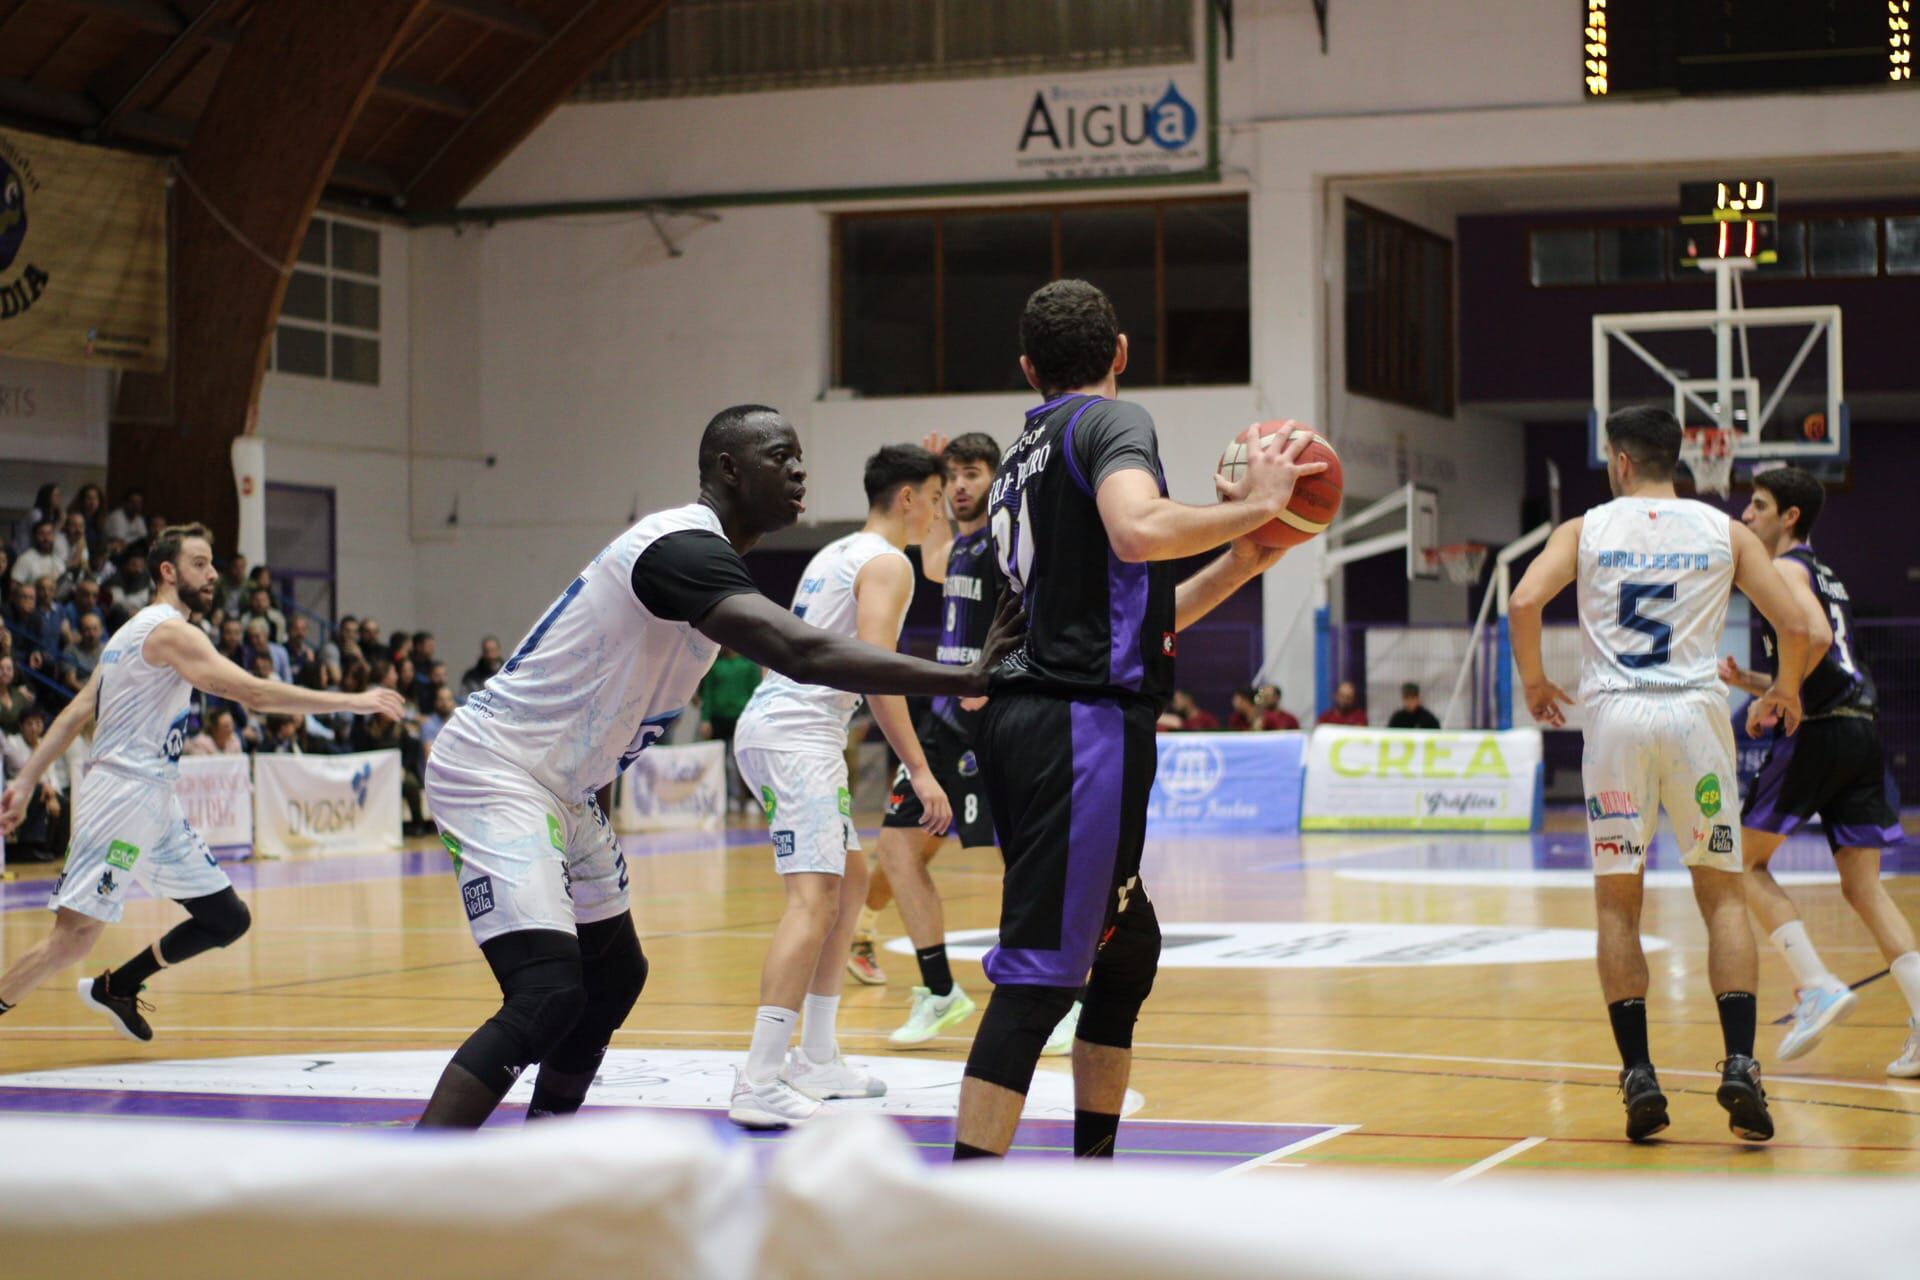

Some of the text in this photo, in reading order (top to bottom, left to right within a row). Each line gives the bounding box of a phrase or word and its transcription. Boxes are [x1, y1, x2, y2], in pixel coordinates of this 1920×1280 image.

[1616, 580, 1678, 669] 5
[1328, 734, 1511, 779] CREA
[964, 793, 978, 824] 8
[463, 880, 489, 903] Font
[466, 896, 493, 918] Vella
